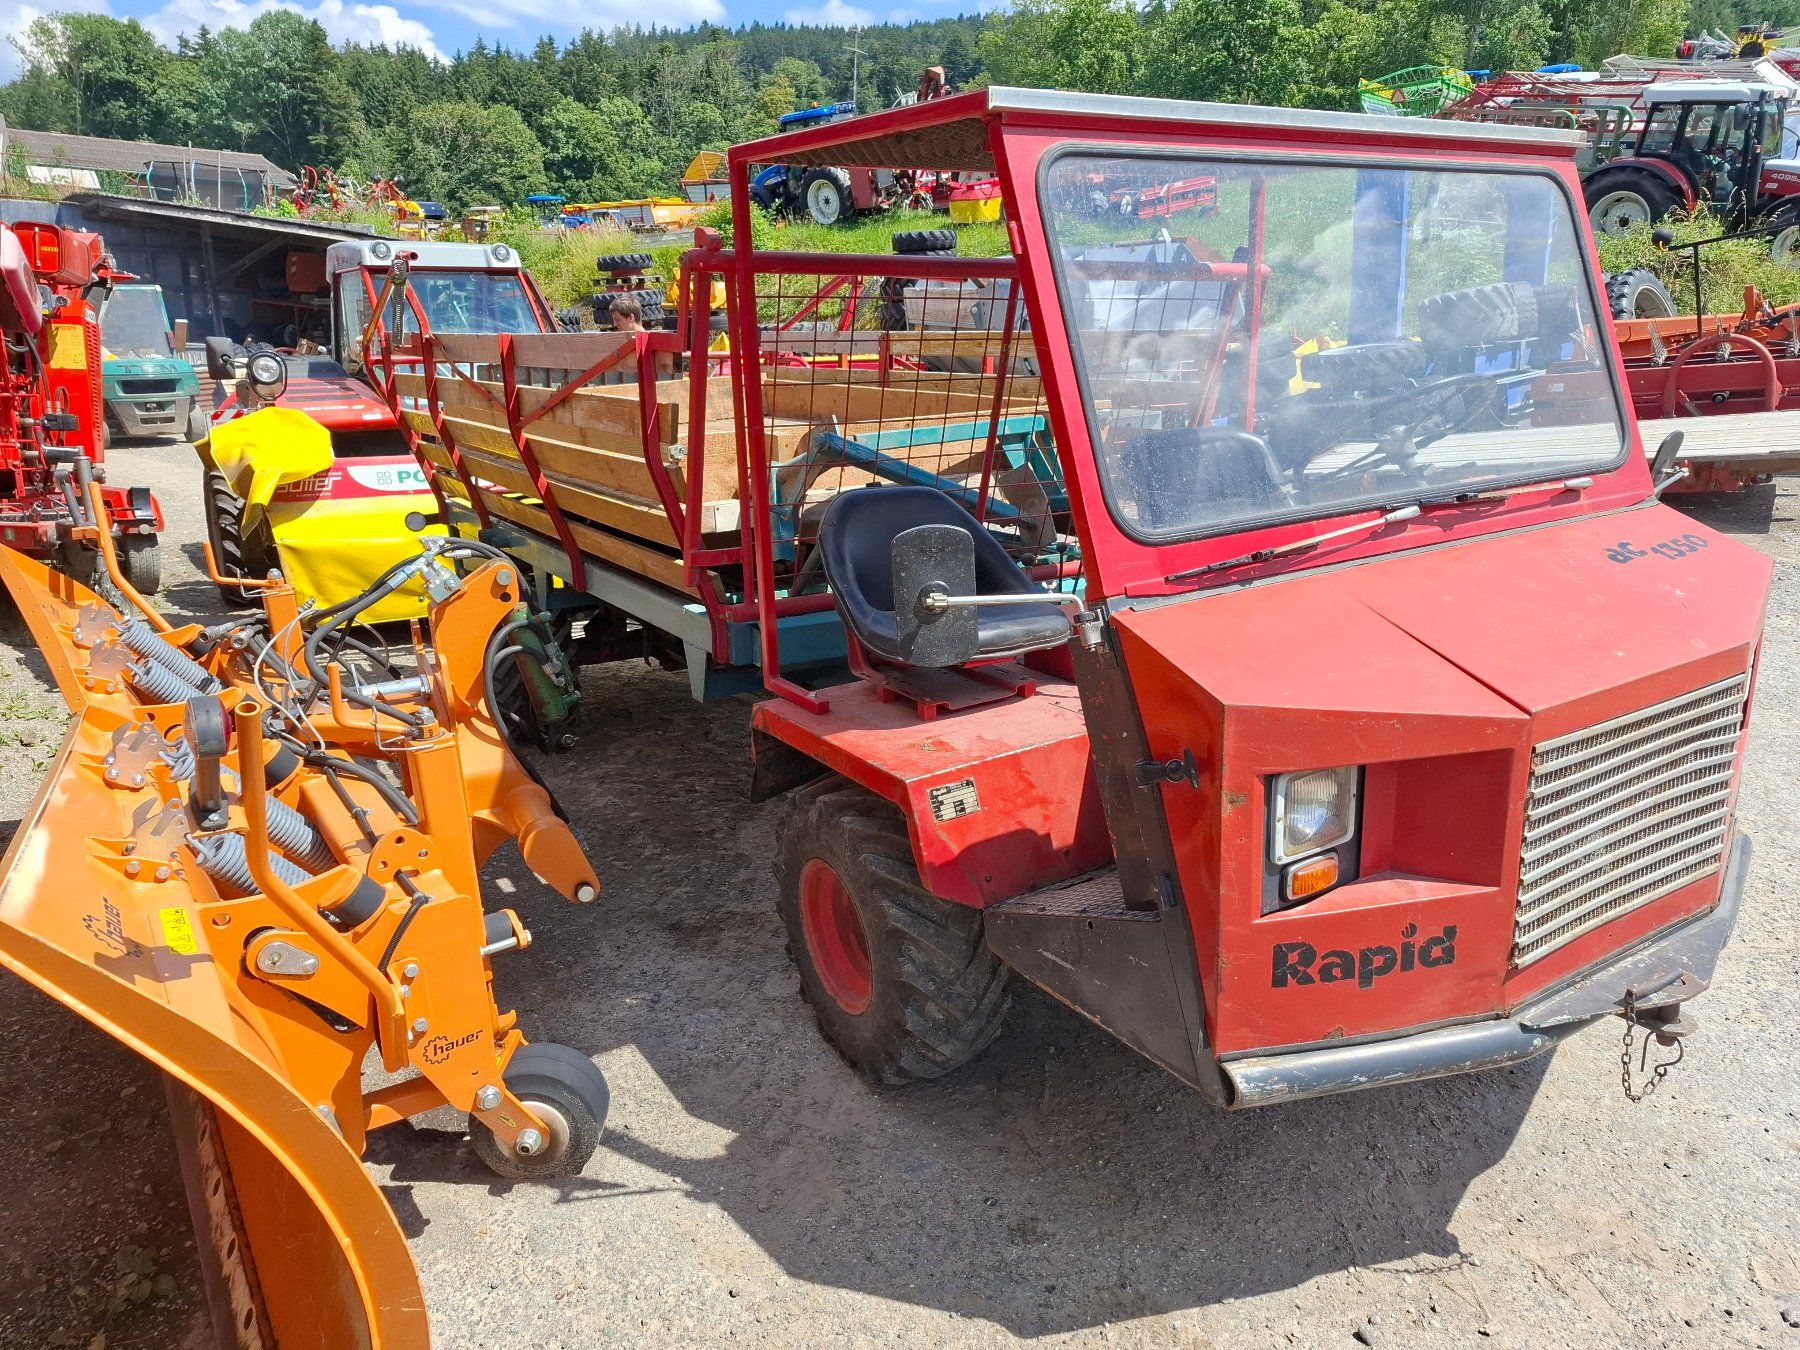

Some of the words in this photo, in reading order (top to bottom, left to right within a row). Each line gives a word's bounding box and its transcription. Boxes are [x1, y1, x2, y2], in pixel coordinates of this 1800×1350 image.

[1650, 533, 1708, 560] 1350
[1272, 923, 1458, 989] Rapid
[433, 1029, 484, 1057] hauer
